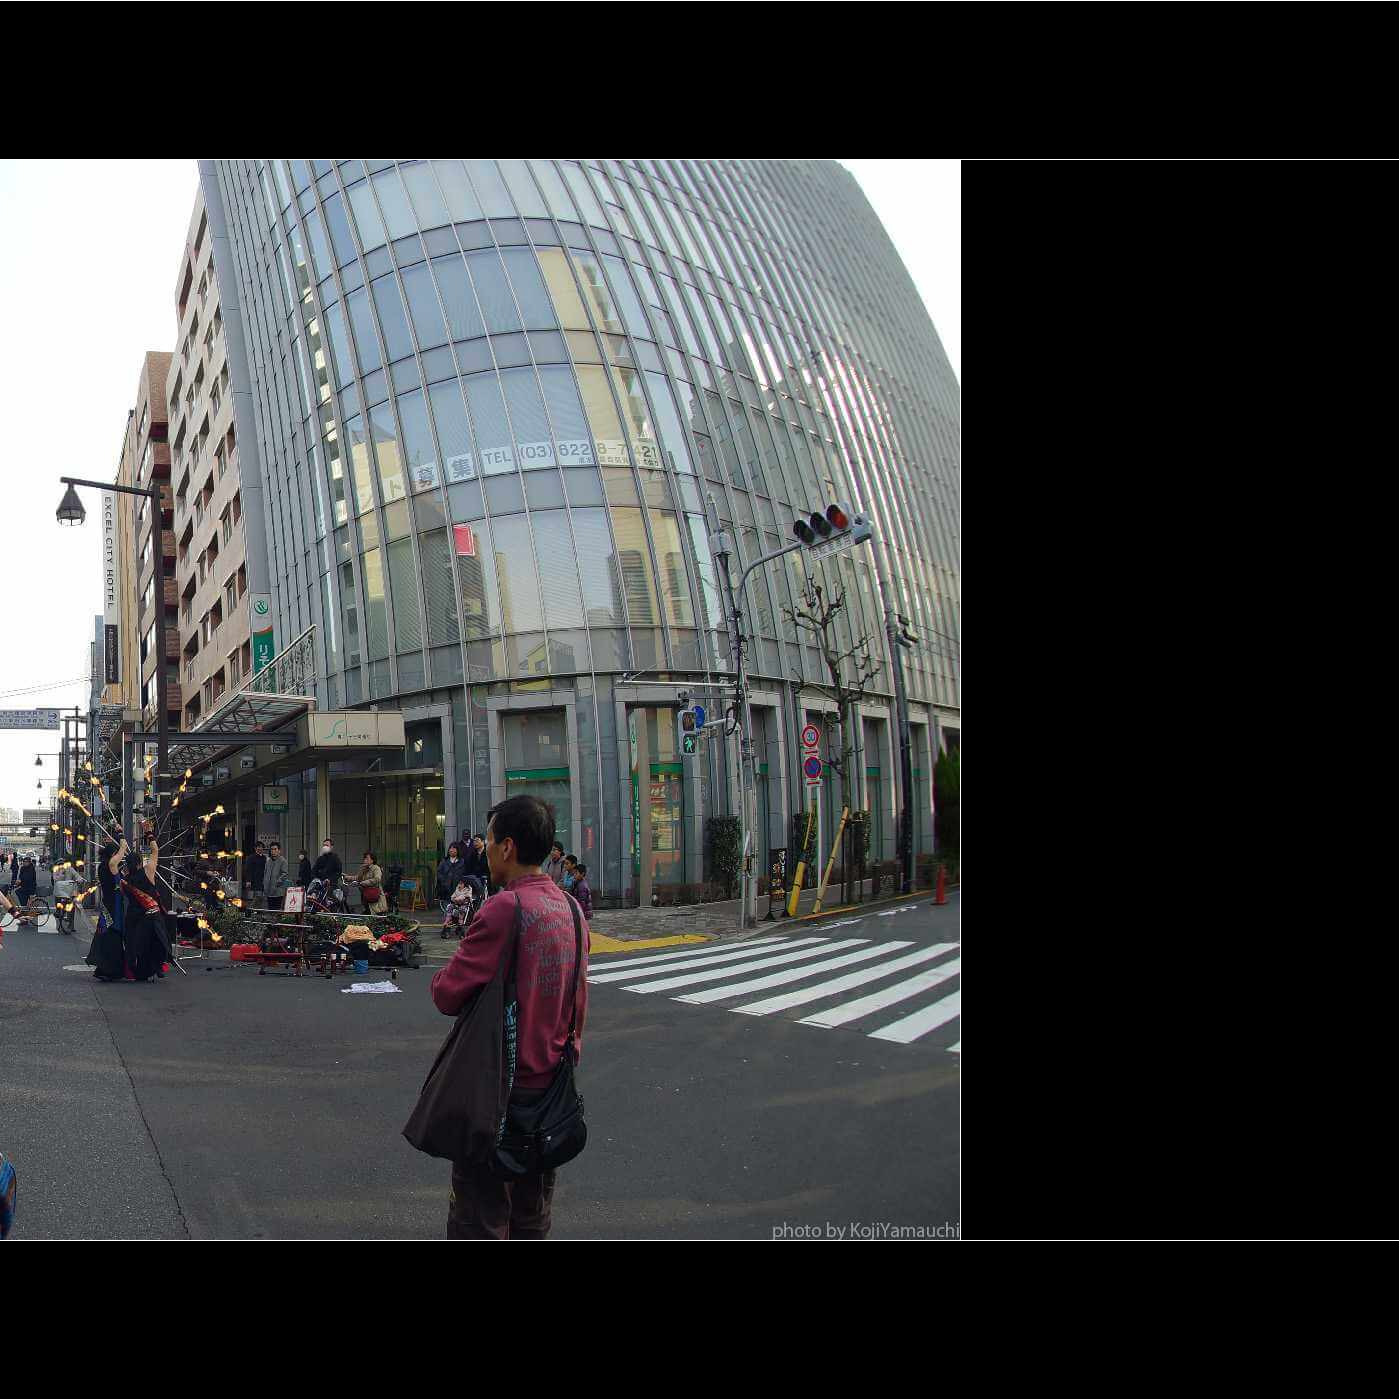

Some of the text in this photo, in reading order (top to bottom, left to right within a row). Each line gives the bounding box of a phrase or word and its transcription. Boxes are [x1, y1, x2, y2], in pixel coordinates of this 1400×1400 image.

[483, 450, 512, 465] TEL
[104, 496, 115, 609] EXCEL CITY HOTEL
